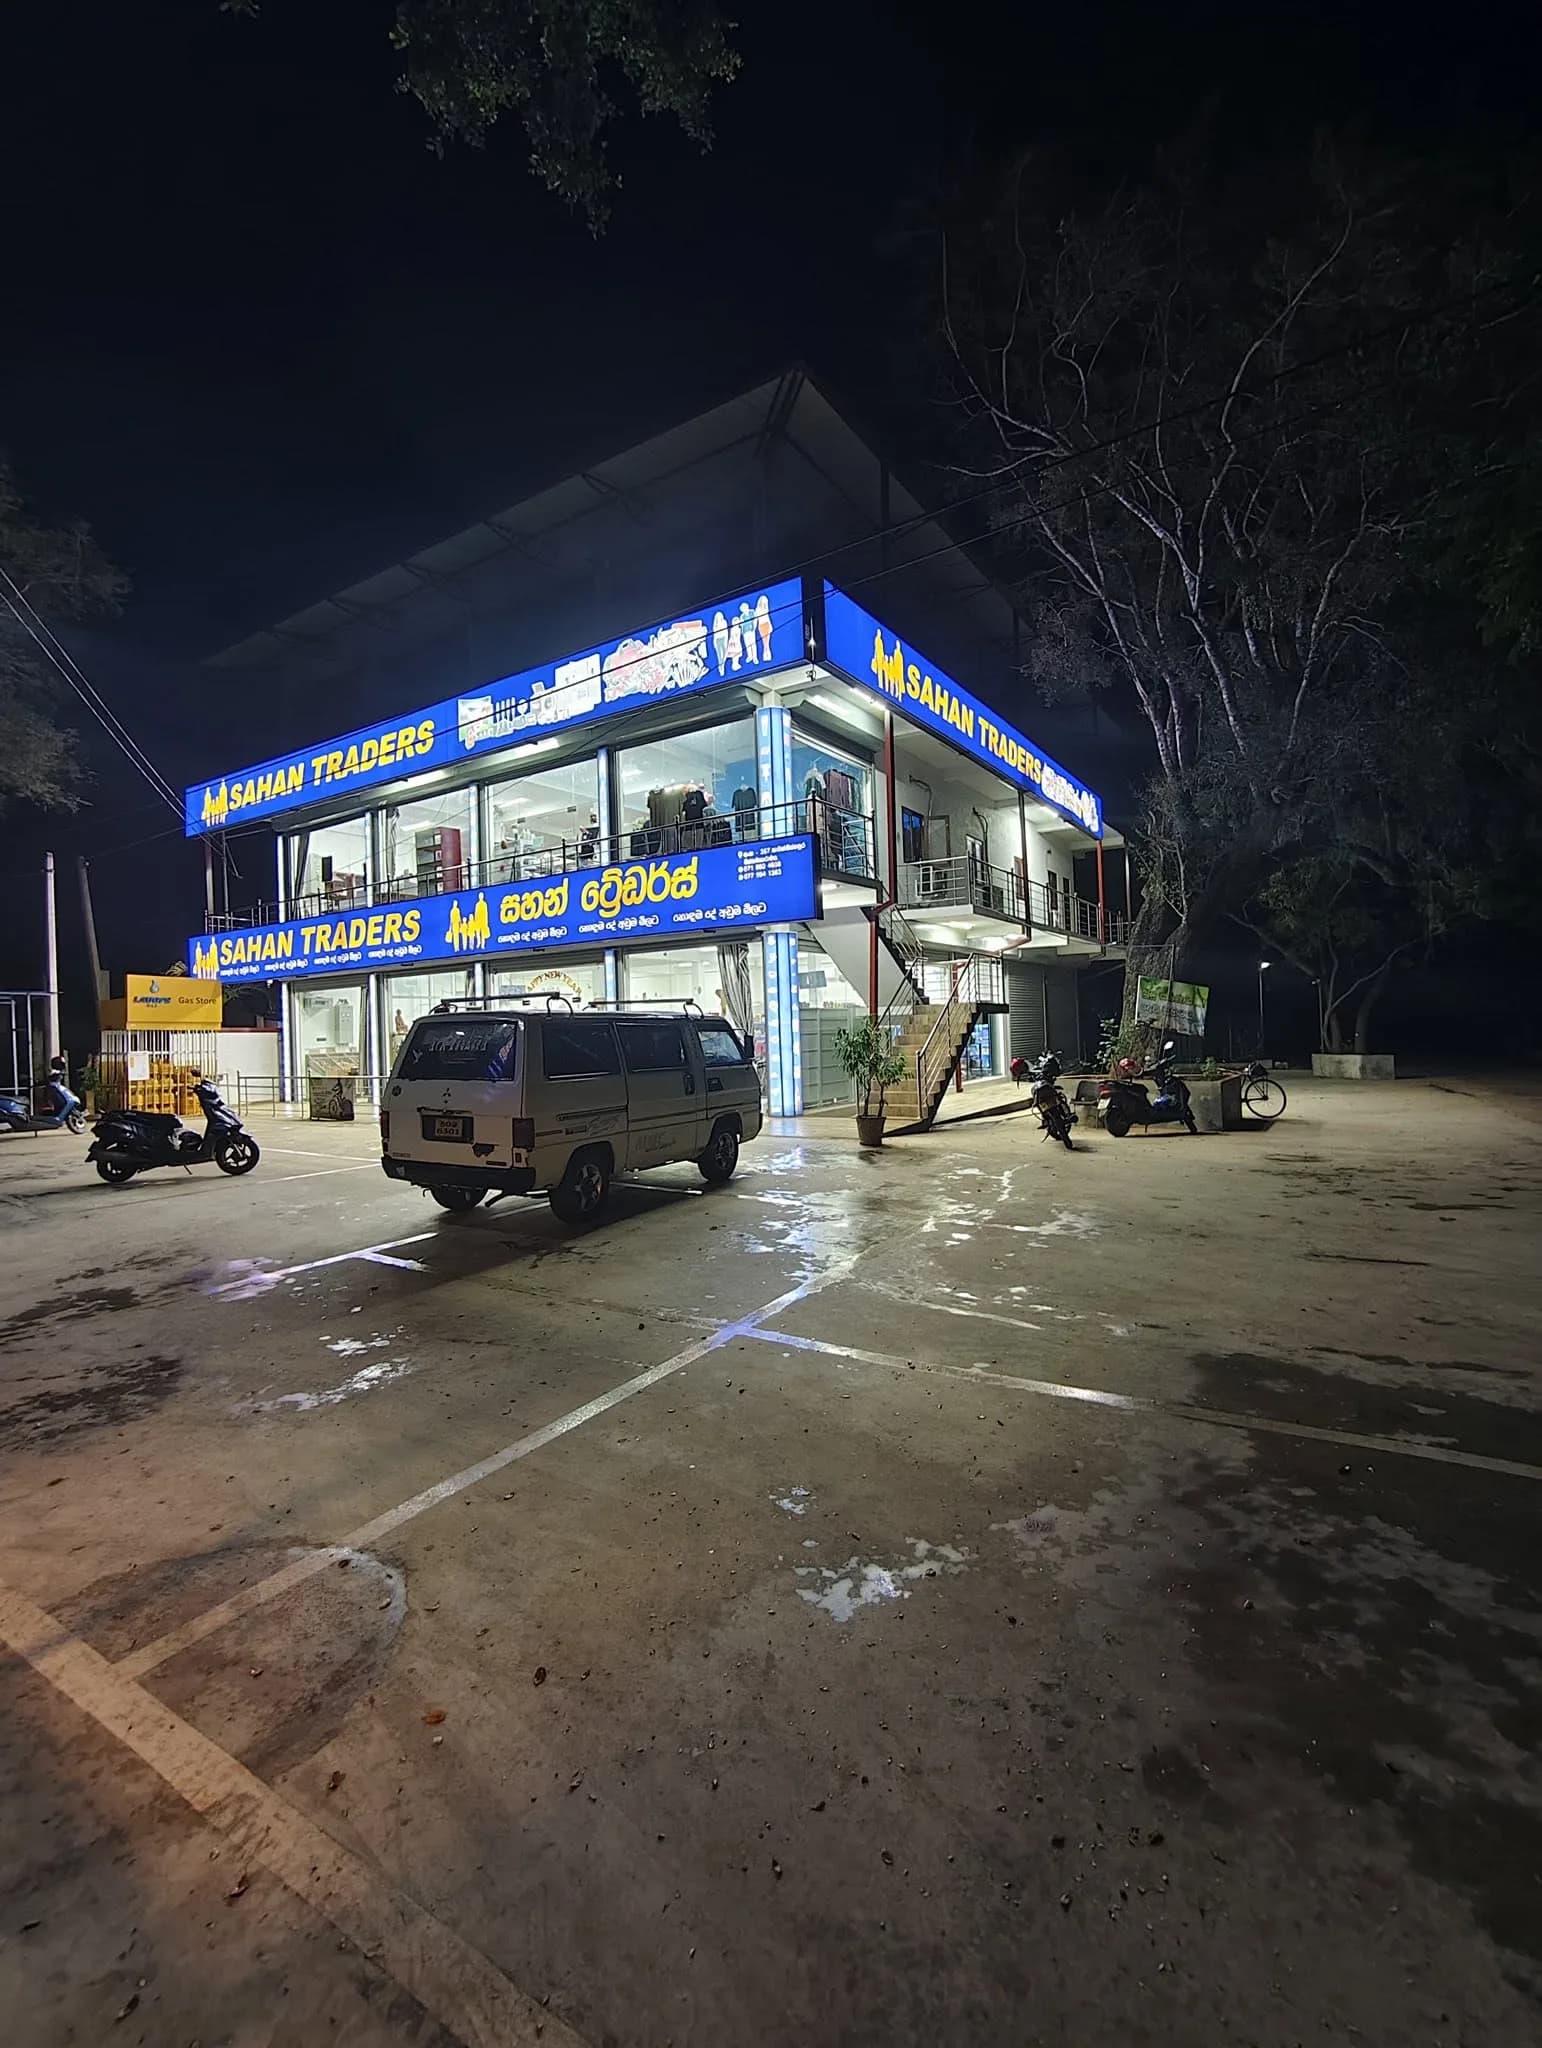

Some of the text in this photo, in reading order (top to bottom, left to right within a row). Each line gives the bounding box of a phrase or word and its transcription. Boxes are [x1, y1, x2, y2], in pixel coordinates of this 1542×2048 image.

[906, 664, 1042, 785] SAHAN TRADERS
[229, 720, 435, 811] SAHAN TRADERS
[500, 877, 569, 924] සහන්
[220, 909, 421, 966] SAHAN TRADERS
[178, 996, 194, 1005] Gas
[195, 996, 216, 1005] Store
[544, 970, 562, 981] NEW
